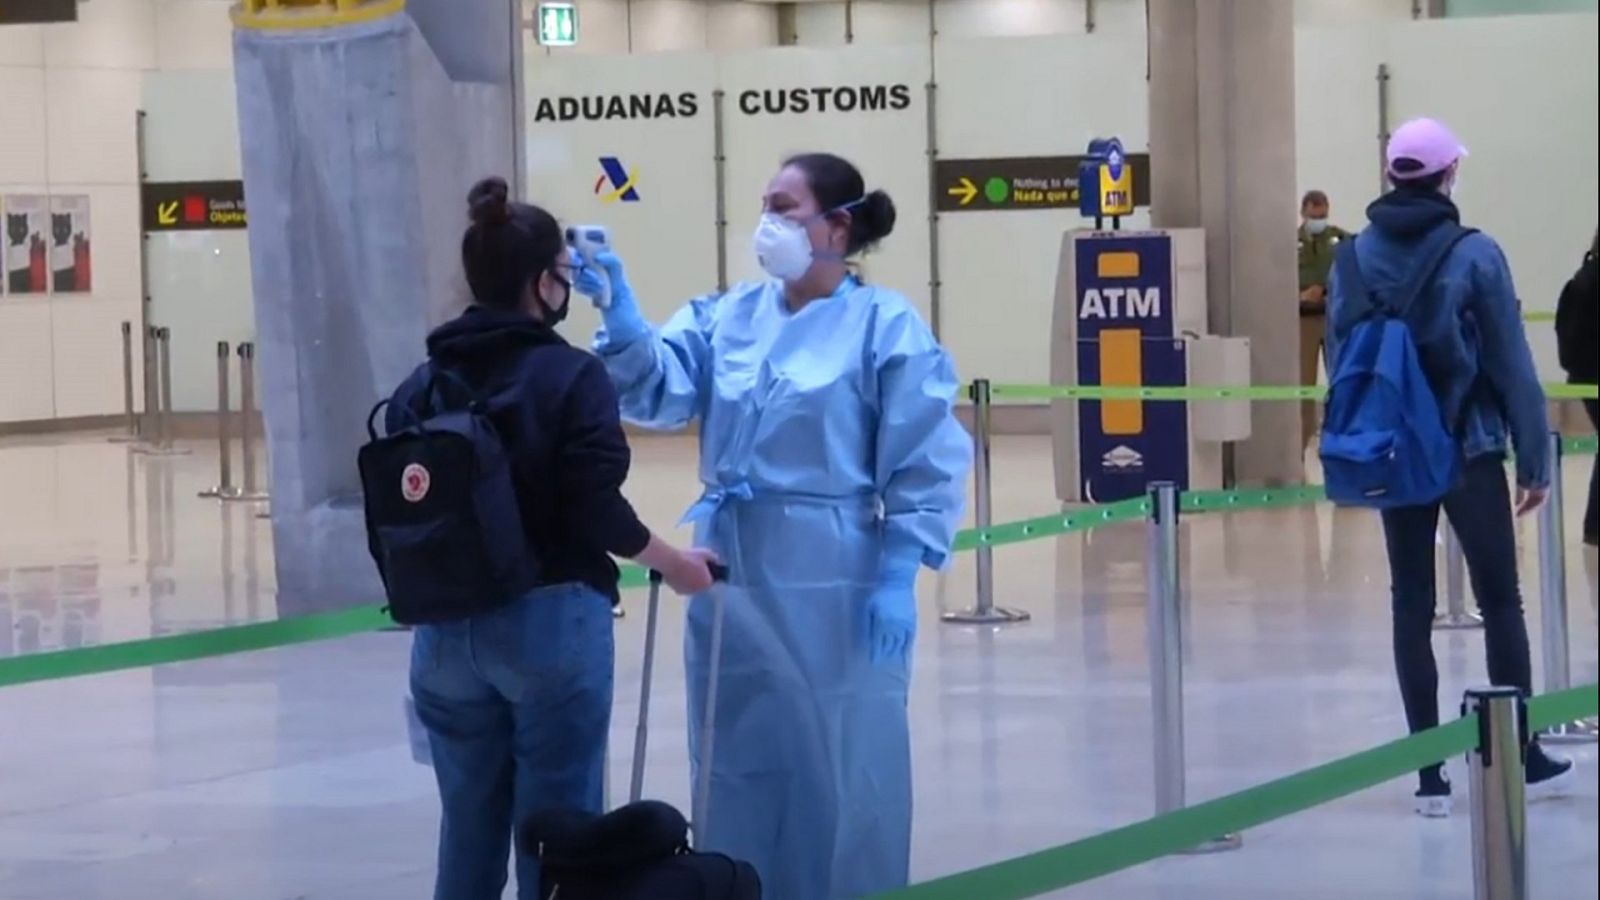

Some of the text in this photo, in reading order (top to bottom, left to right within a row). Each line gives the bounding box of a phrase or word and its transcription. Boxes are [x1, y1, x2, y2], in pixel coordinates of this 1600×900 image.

[534, 92, 699, 122] ADUANAS
[738, 84, 912, 115] CUSTOMS
[1013, 177, 1048, 190] Nothing
[1014, 189, 1043, 202] Nada
[1047, 192, 1069, 203] que
[1105, 190, 1127, 206] ATM
[1080, 287, 1161, 319] ATM
